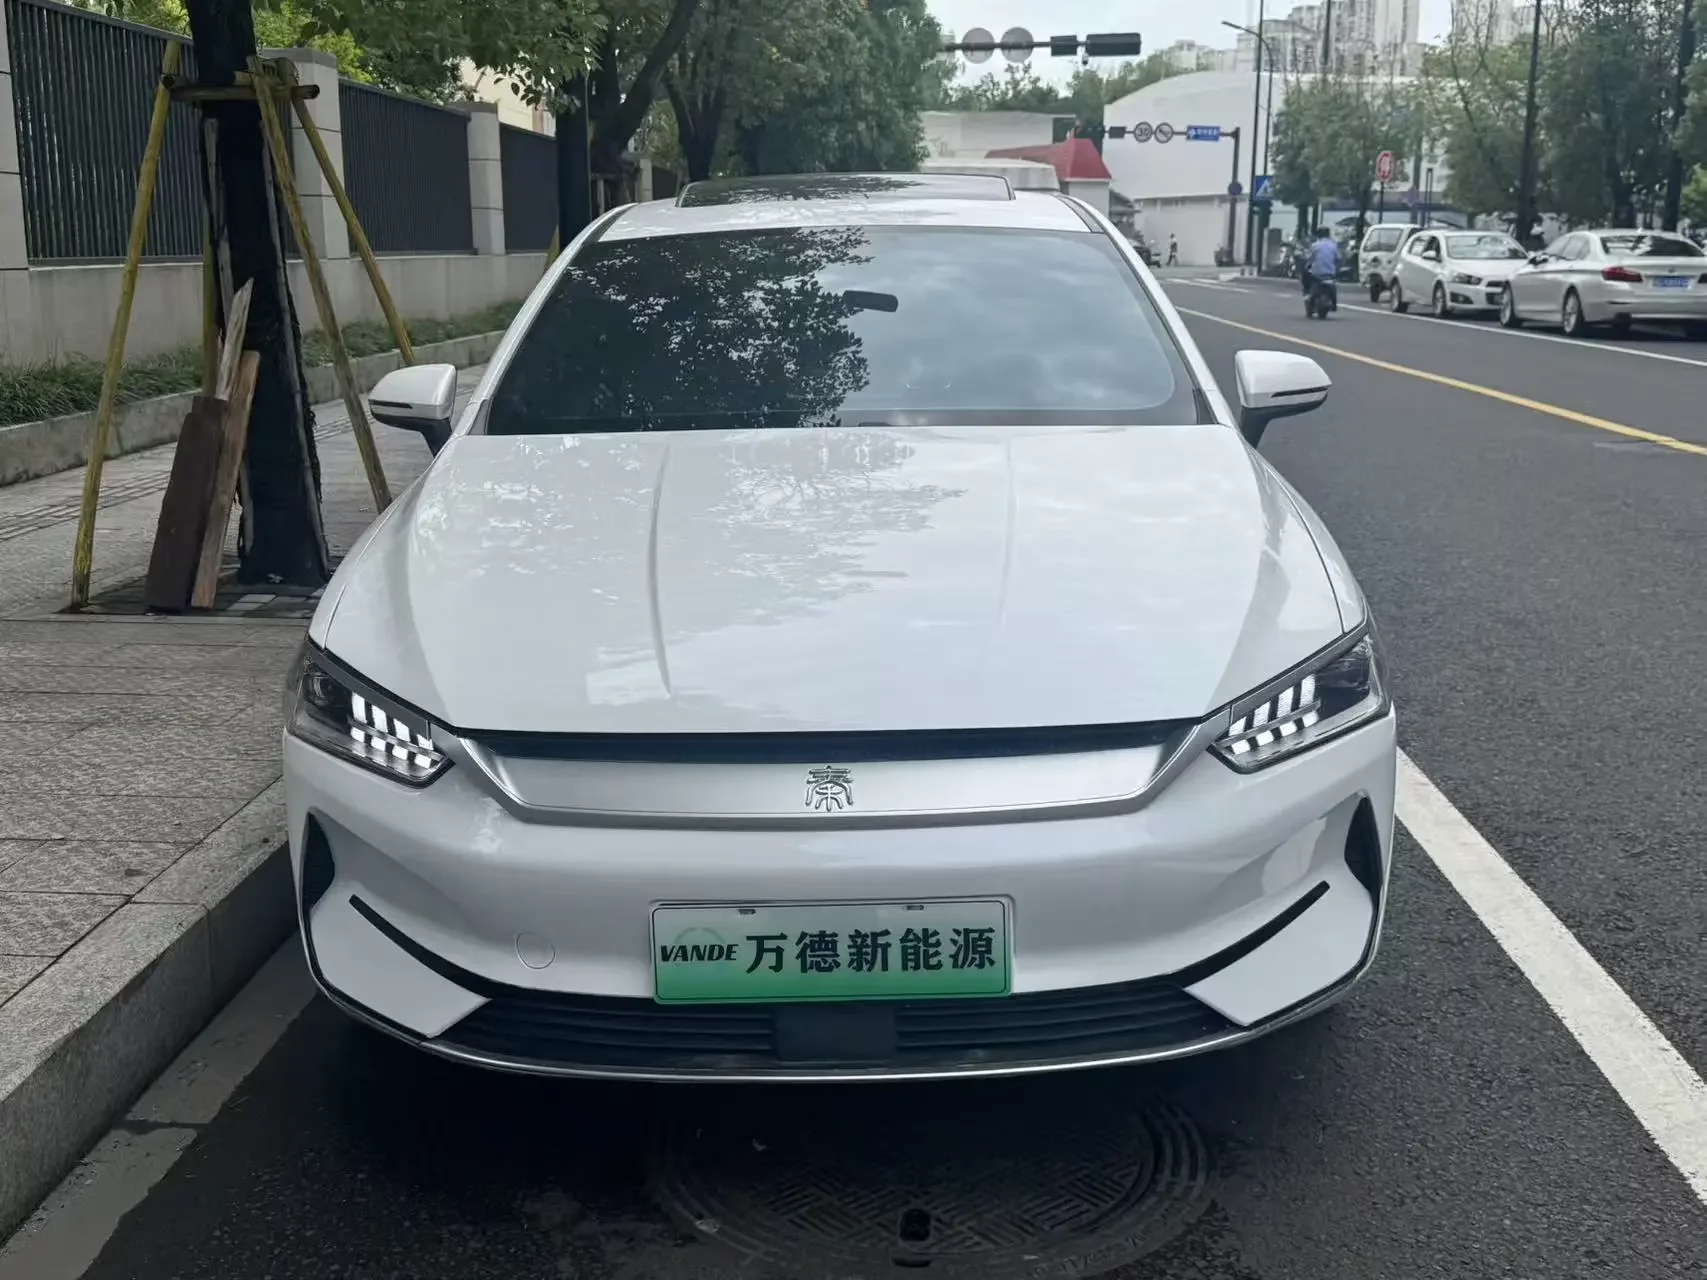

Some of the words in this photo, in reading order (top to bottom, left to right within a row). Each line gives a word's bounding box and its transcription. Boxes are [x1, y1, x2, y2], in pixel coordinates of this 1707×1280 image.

[805, 764, 854, 812] 秦
[660, 943, 739, 963] VANDE
[745, 926, 997, 974] 万德新能源
